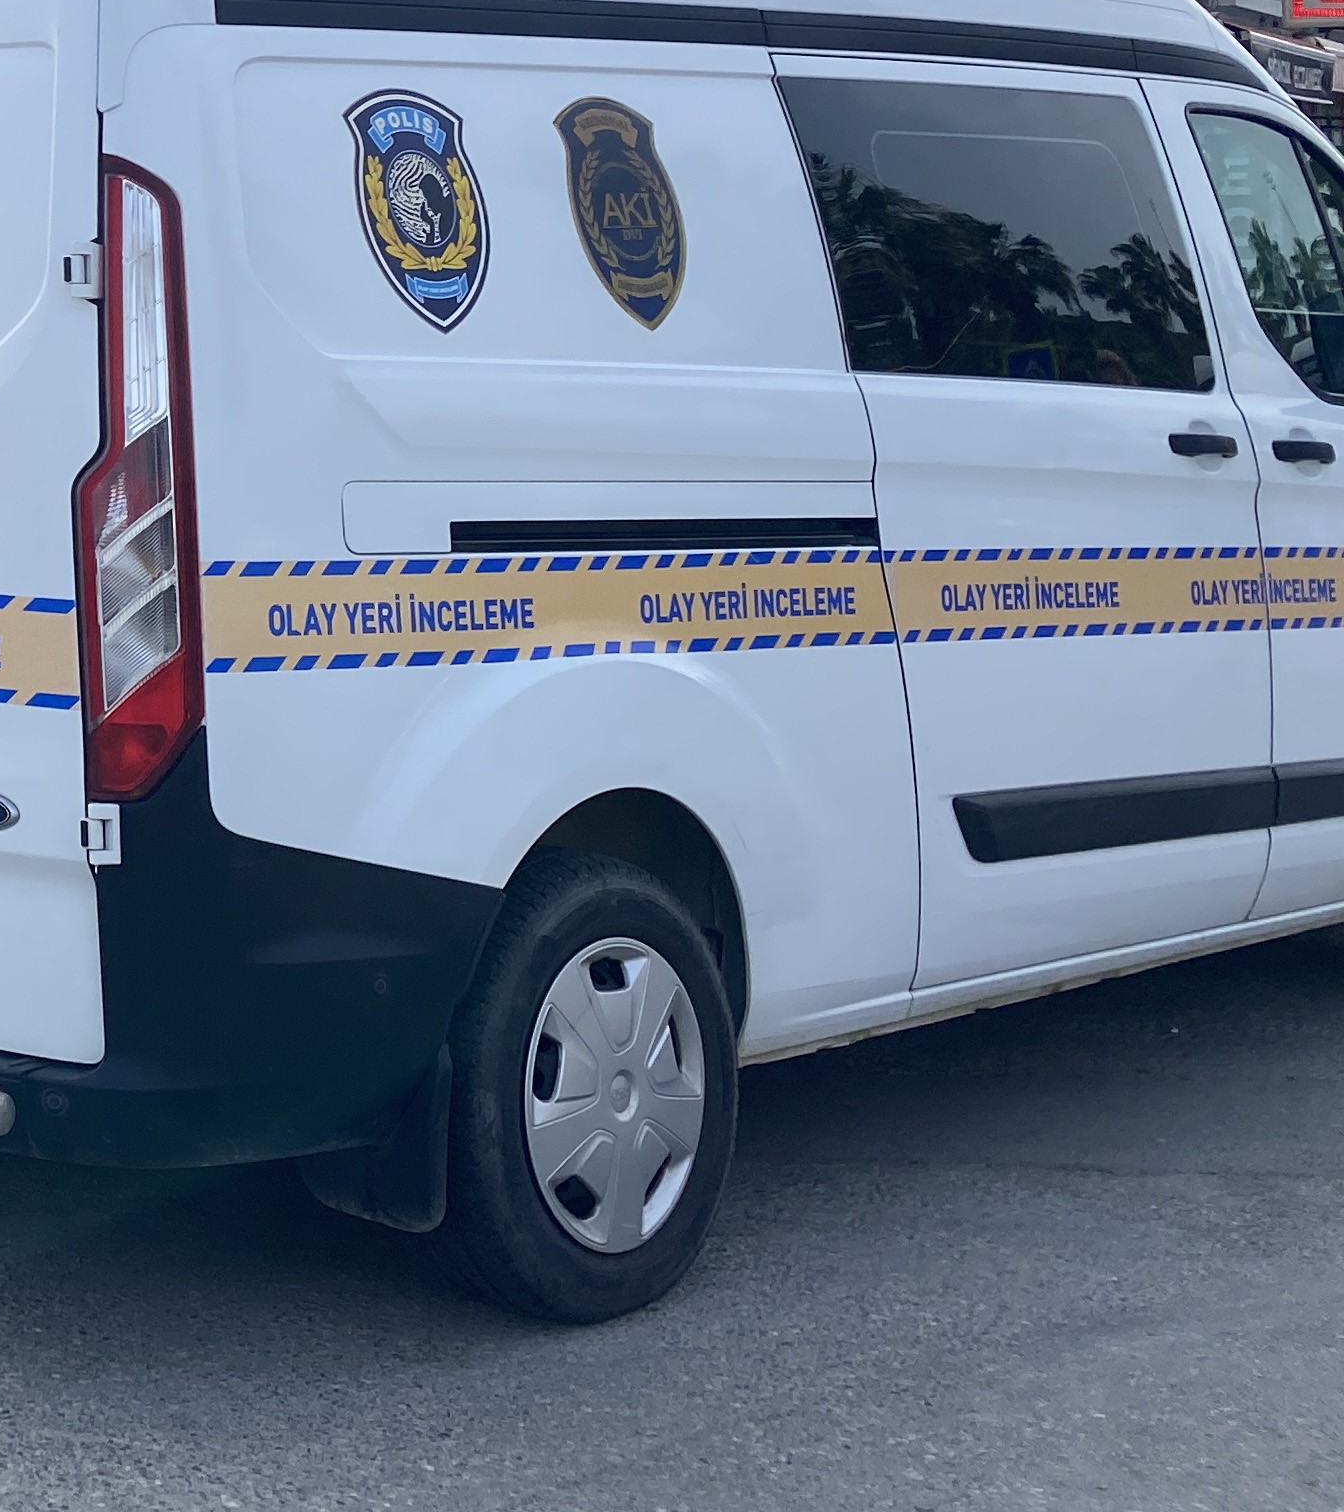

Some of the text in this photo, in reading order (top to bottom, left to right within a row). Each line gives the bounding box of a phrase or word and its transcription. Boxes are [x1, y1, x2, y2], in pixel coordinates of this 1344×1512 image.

[374, 108, 435, 137] POLİS
[639, 592, 696, 624] OLAY
[700, 582, 748, 621] YERİ
[940, 575, 1121, 612] OLAY YERİ İNCELEME
[1190, 572, 1337, 606] OLAY YERİ İNCELEME
[267, 593, 535, 637] OLAY YERİ İNCELEME
